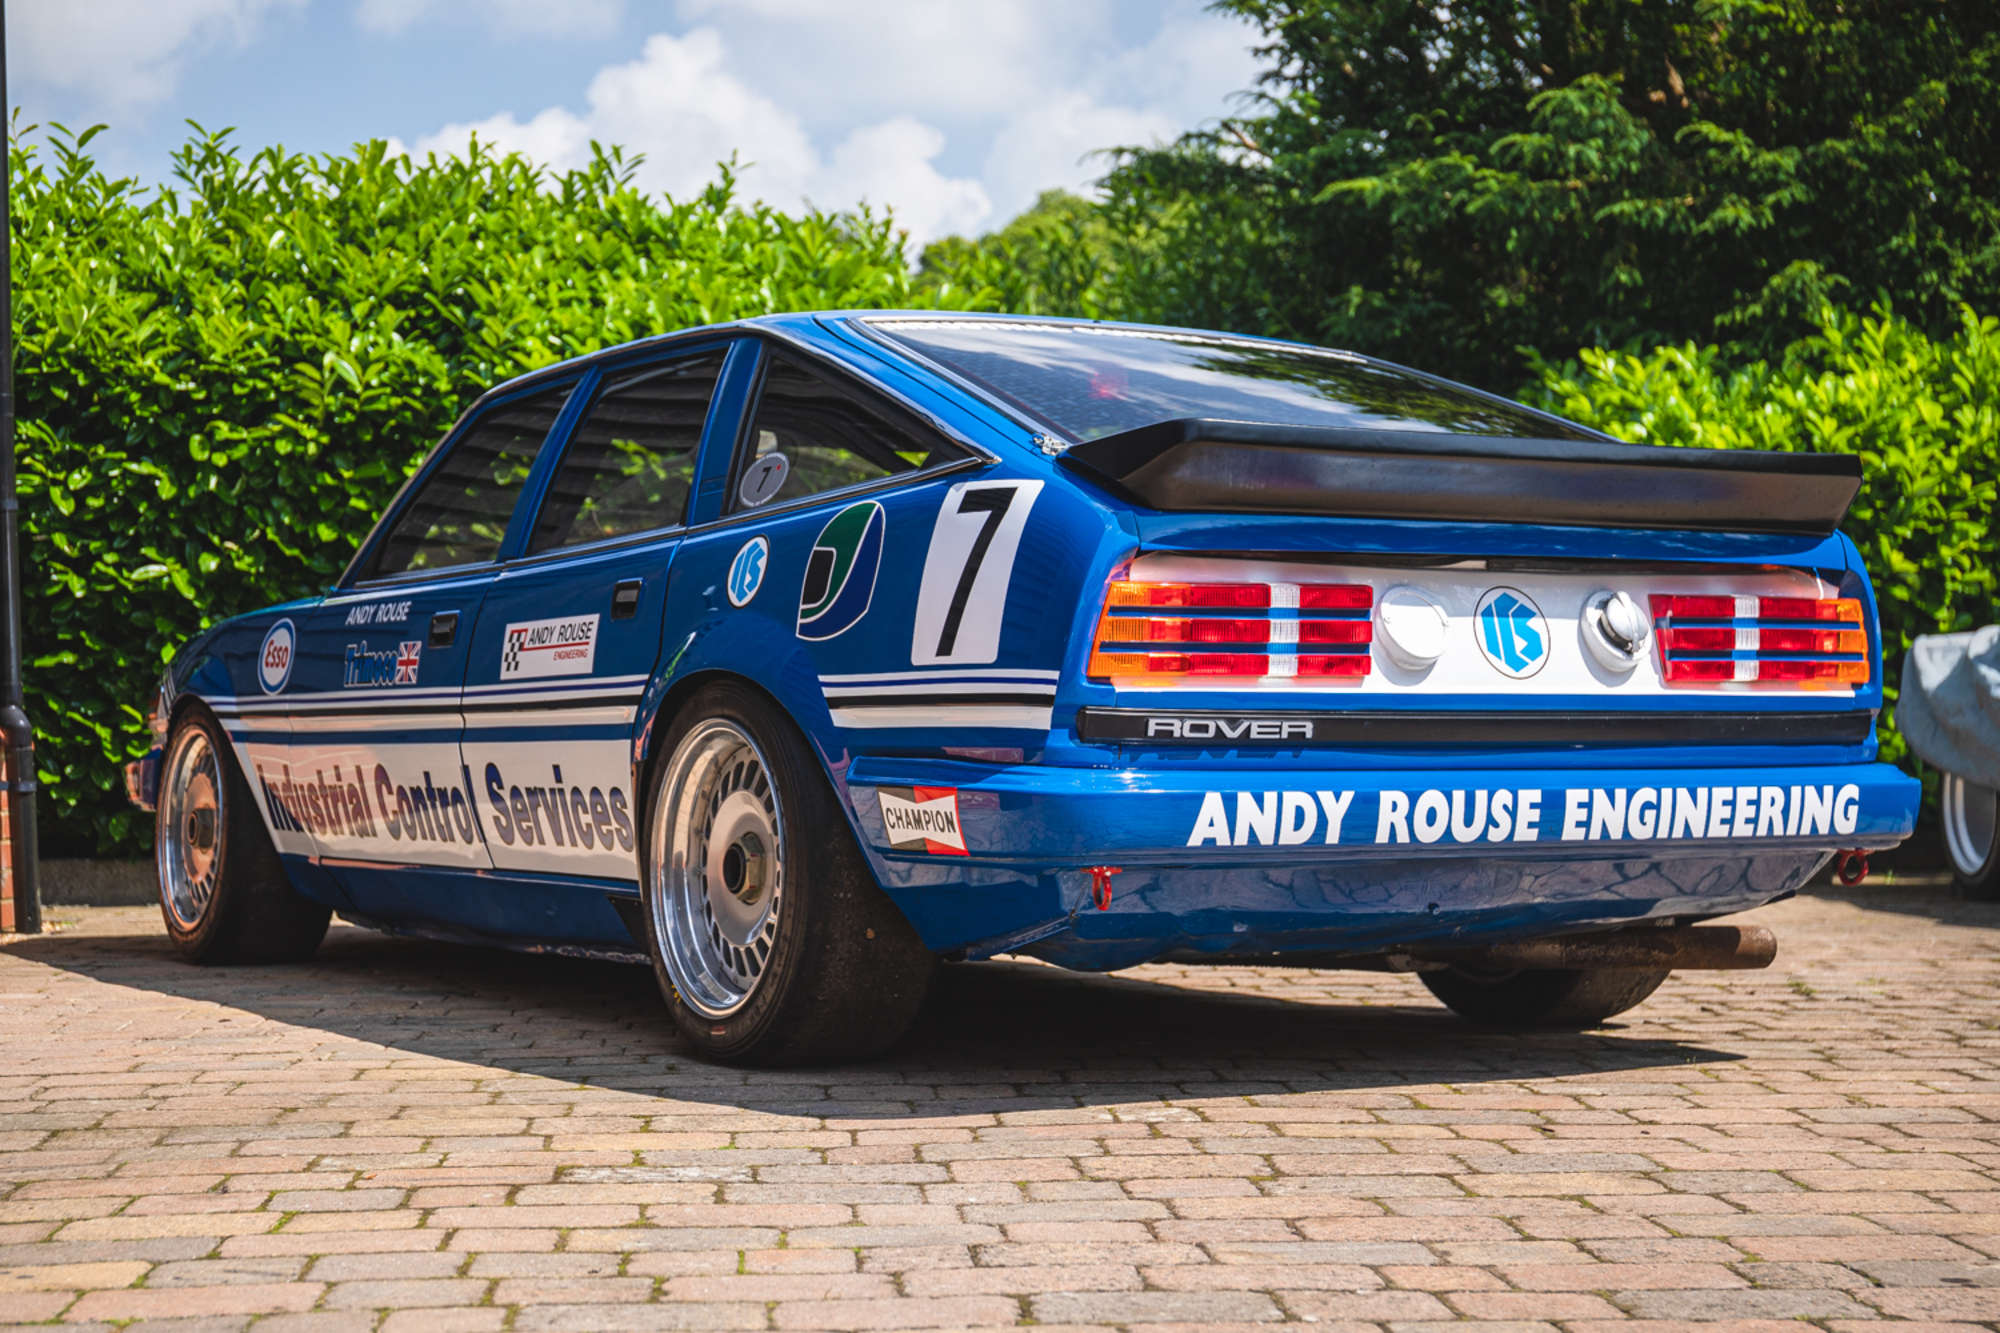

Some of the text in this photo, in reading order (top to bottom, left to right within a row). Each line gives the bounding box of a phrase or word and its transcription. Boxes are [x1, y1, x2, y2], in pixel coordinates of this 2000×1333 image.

[757, 466, 772, 493] 7
[935, 486, 1018, 658] 7
[345, 601, 412, 626] ANDY ROUSE
[528, 620, 594, 645] ANDY ROUSE
[553, 648, 588, 661] ENGINEERING
[1147, 717, 1314, 740] ROVER
[256, 762, 635, 853] Industrial Control Services
[884, 805, 957, 836] CHAMPION
[1186, 783, 1861, 847] ANDY ROUSE ENGINEERING
